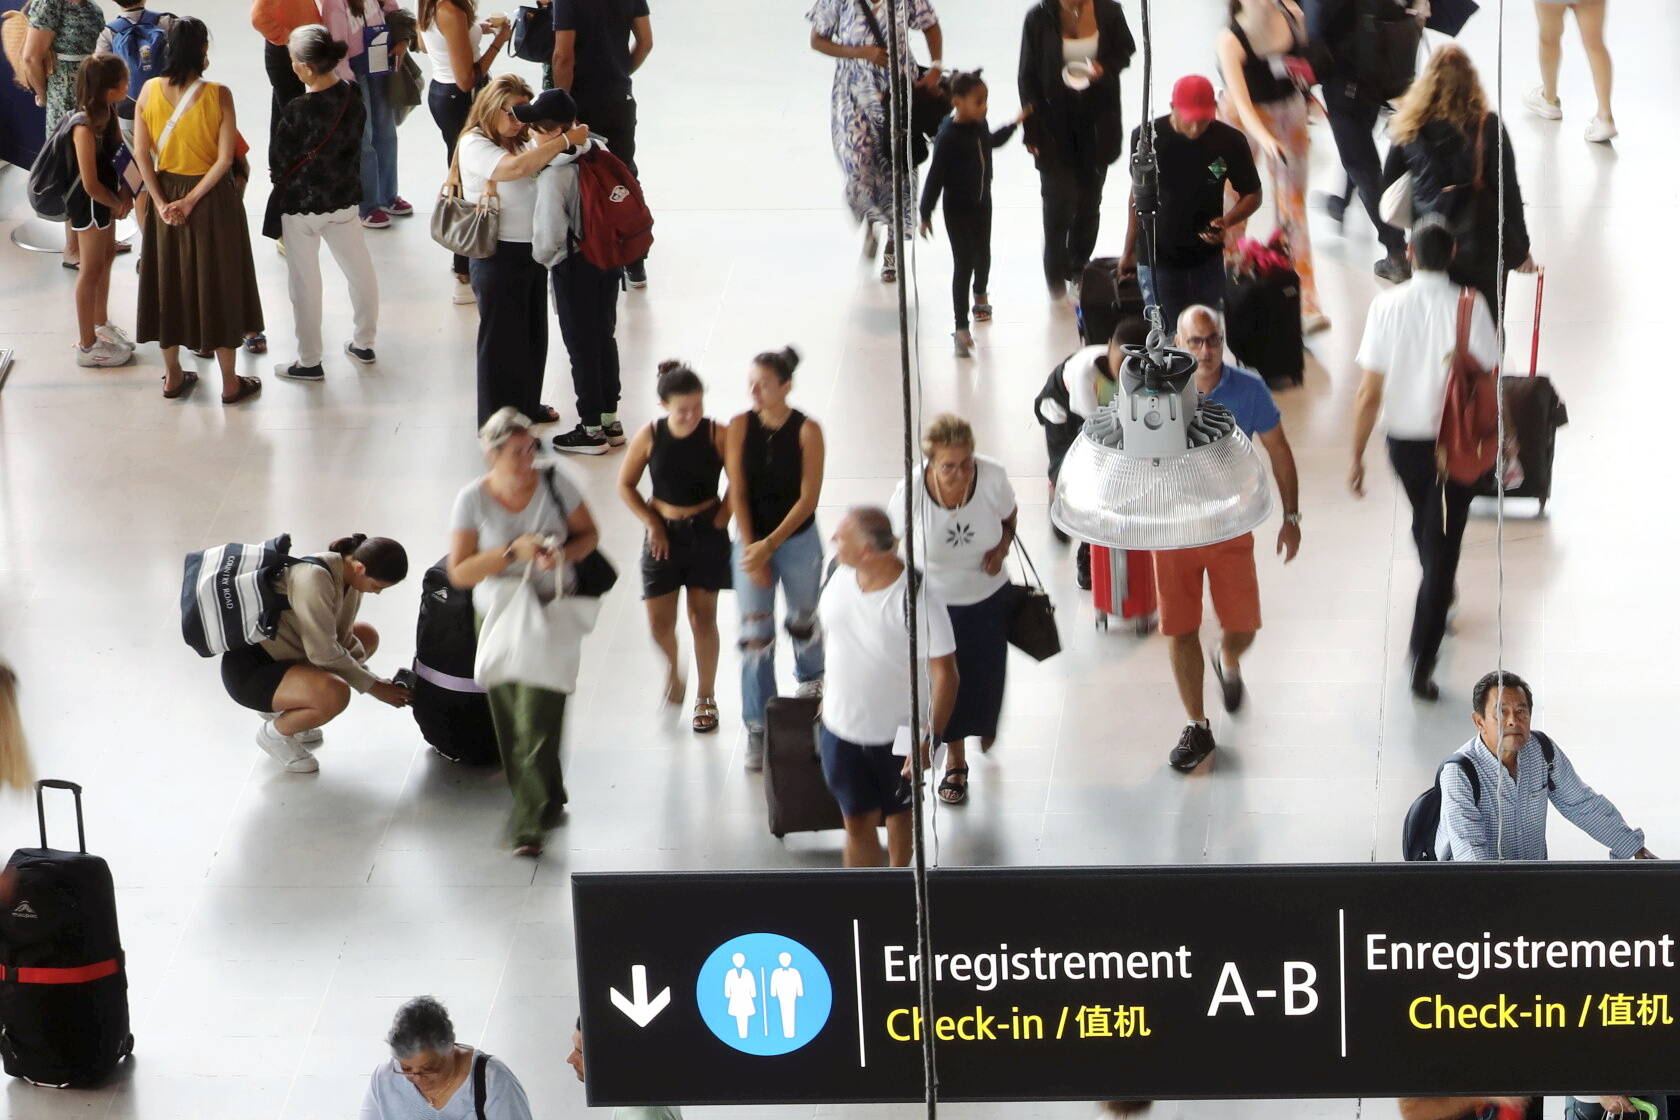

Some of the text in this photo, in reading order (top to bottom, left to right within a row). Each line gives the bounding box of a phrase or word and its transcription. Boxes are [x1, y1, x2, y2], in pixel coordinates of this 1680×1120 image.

[222, 587, 234, 609] ROAD
[885, 944, 1192, 991] Enregistrement
[1367, 932, 1674, 979] Enregistrement
[1207, 961, 1318, 1017] A-B
[887, 1006, 1044, 1042] Check-in
[1075, 1005, 1151, 1039] 值机
[1409, 993, 1565, 1029] Check-in
[1598, 992, 1674, 1026] 值机
